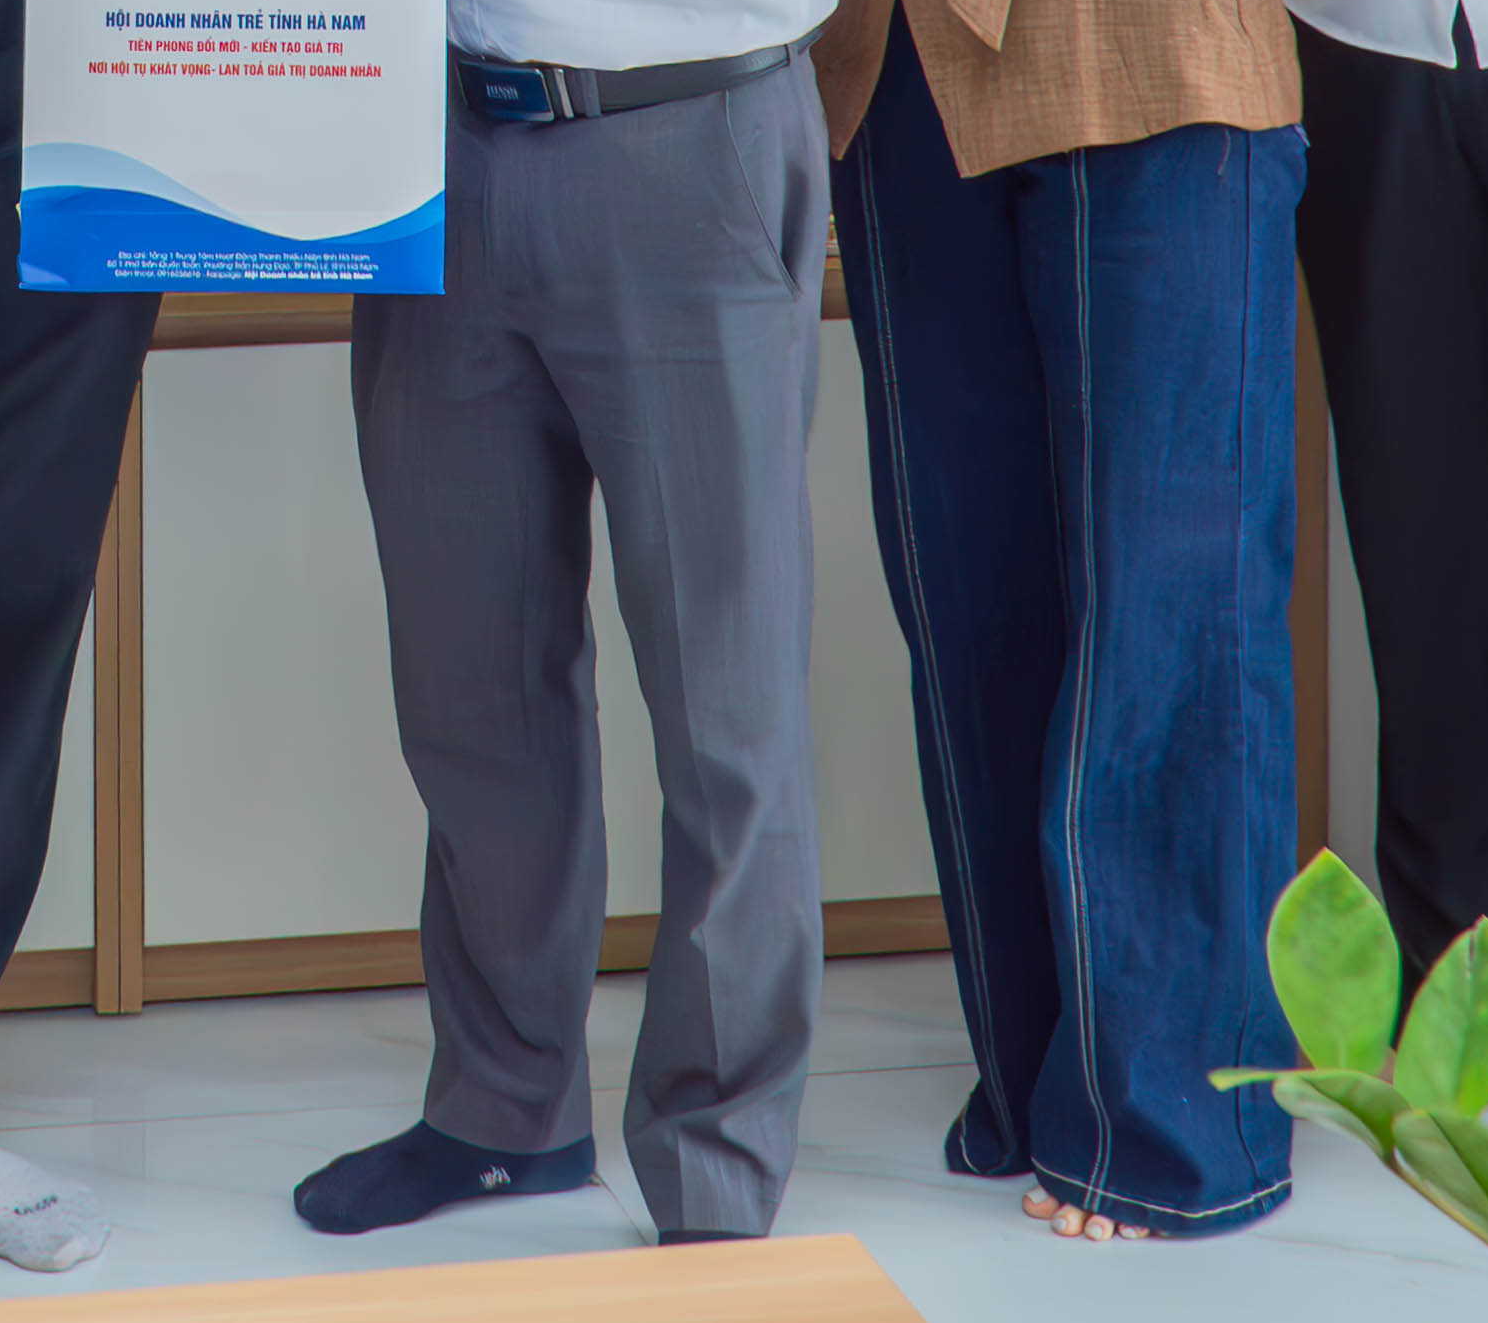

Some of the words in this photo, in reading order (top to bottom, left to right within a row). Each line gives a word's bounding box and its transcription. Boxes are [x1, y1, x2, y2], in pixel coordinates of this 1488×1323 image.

[106, 9, 129, 31] HỘI
[135, 13, 185, 29] DOANH
[190, 10, 232, 29] NHÂN
[237, 9, 263, 29] TRẺ
[268, 9, 302, 29] TỈNH
[307, 11, 326, 30] HÀ
[331, 14, 366, 30] NAM
[156, 40, 193, 52] PHONG
[281, 41, 301, 55] TẠO
[304, 39, 323, 54] GIÁ
[326, 42, 343, 56] TRỊ
[133, 63, 146, 77] TỤ
[219, 64, 240, 76] LAN
[267, 62, 286, 76] GIÁ
[289, 64, 306, 79] TRỊ
[309, 65, 347, 77] DOANH
[350, 63, 382, 77] NHÂN
